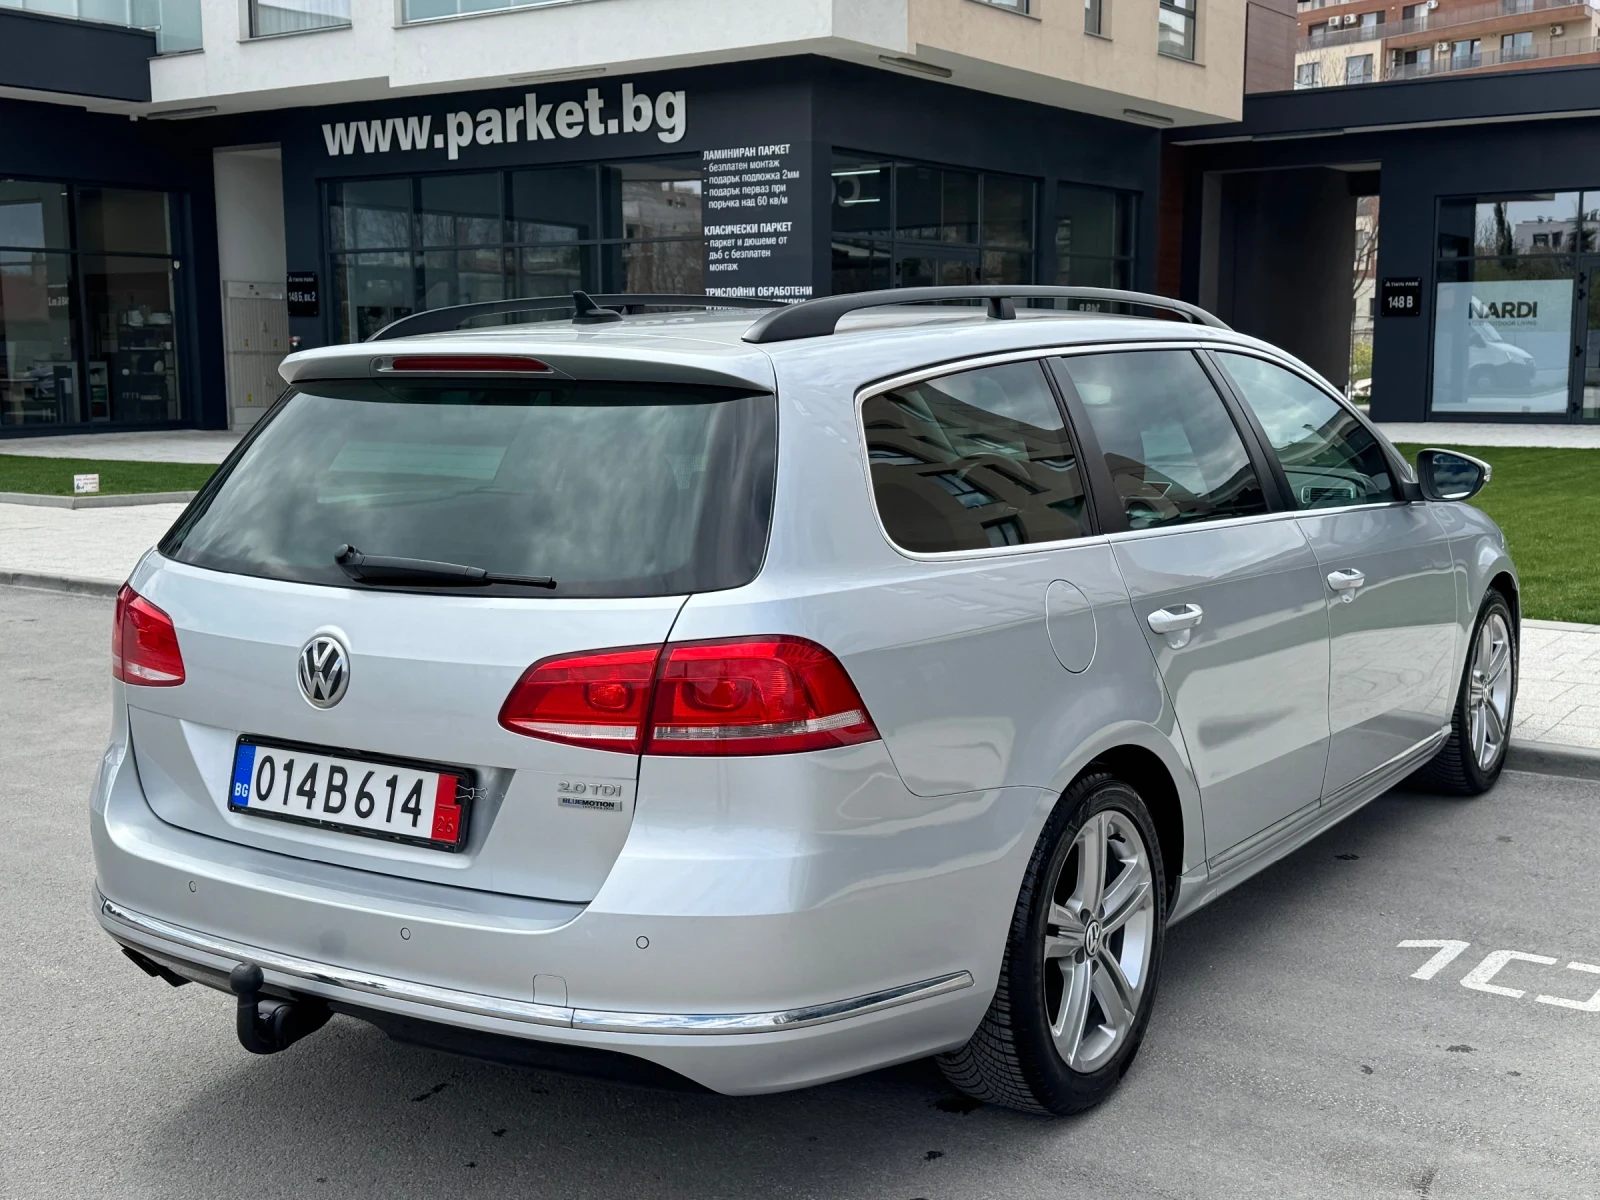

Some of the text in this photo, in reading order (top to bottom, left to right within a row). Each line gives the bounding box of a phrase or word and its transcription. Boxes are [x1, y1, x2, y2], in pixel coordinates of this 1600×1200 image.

[321, 82, 686, 161] www.parket.bg
[703, 144, 790, 161] ЛАМИНИРАН ПАРКЕТ
[708, 159, 780, 172] безплатен монтаж
[742, 171, 780, 183] подложка
[782, 169, 800, 180] 2мм
[742, 185, 769, 195] перваз
[771, 183, 786, 194] при
[741, 197, 756, 207] над
[757, 195, 768, 206] 60
[769, 194, 788, 205] кв/м
[704, 221, 792, 236] КЛАСИЧЕСКИ ПАРКЕТ
[710, 236, 788, 248] паркет и дюшеме от
[724, 251, 729, 259] с
[731, 249, 771, 259] безплатен
[709, 262, 738, 271] монтаж
[705, 286, 813, 297] ТРИСЛОЙНИ ОБРАБОТЕНИ
[1387, 295, 1405, 309] 148
[1468, 301, 1538, 319] NARDI
[234, 755, 454, 833] BG 014B614 26
[557, 780, 622, 797] 2.0 TDI
[562, 798, 615, 807] BLUEMOTION
